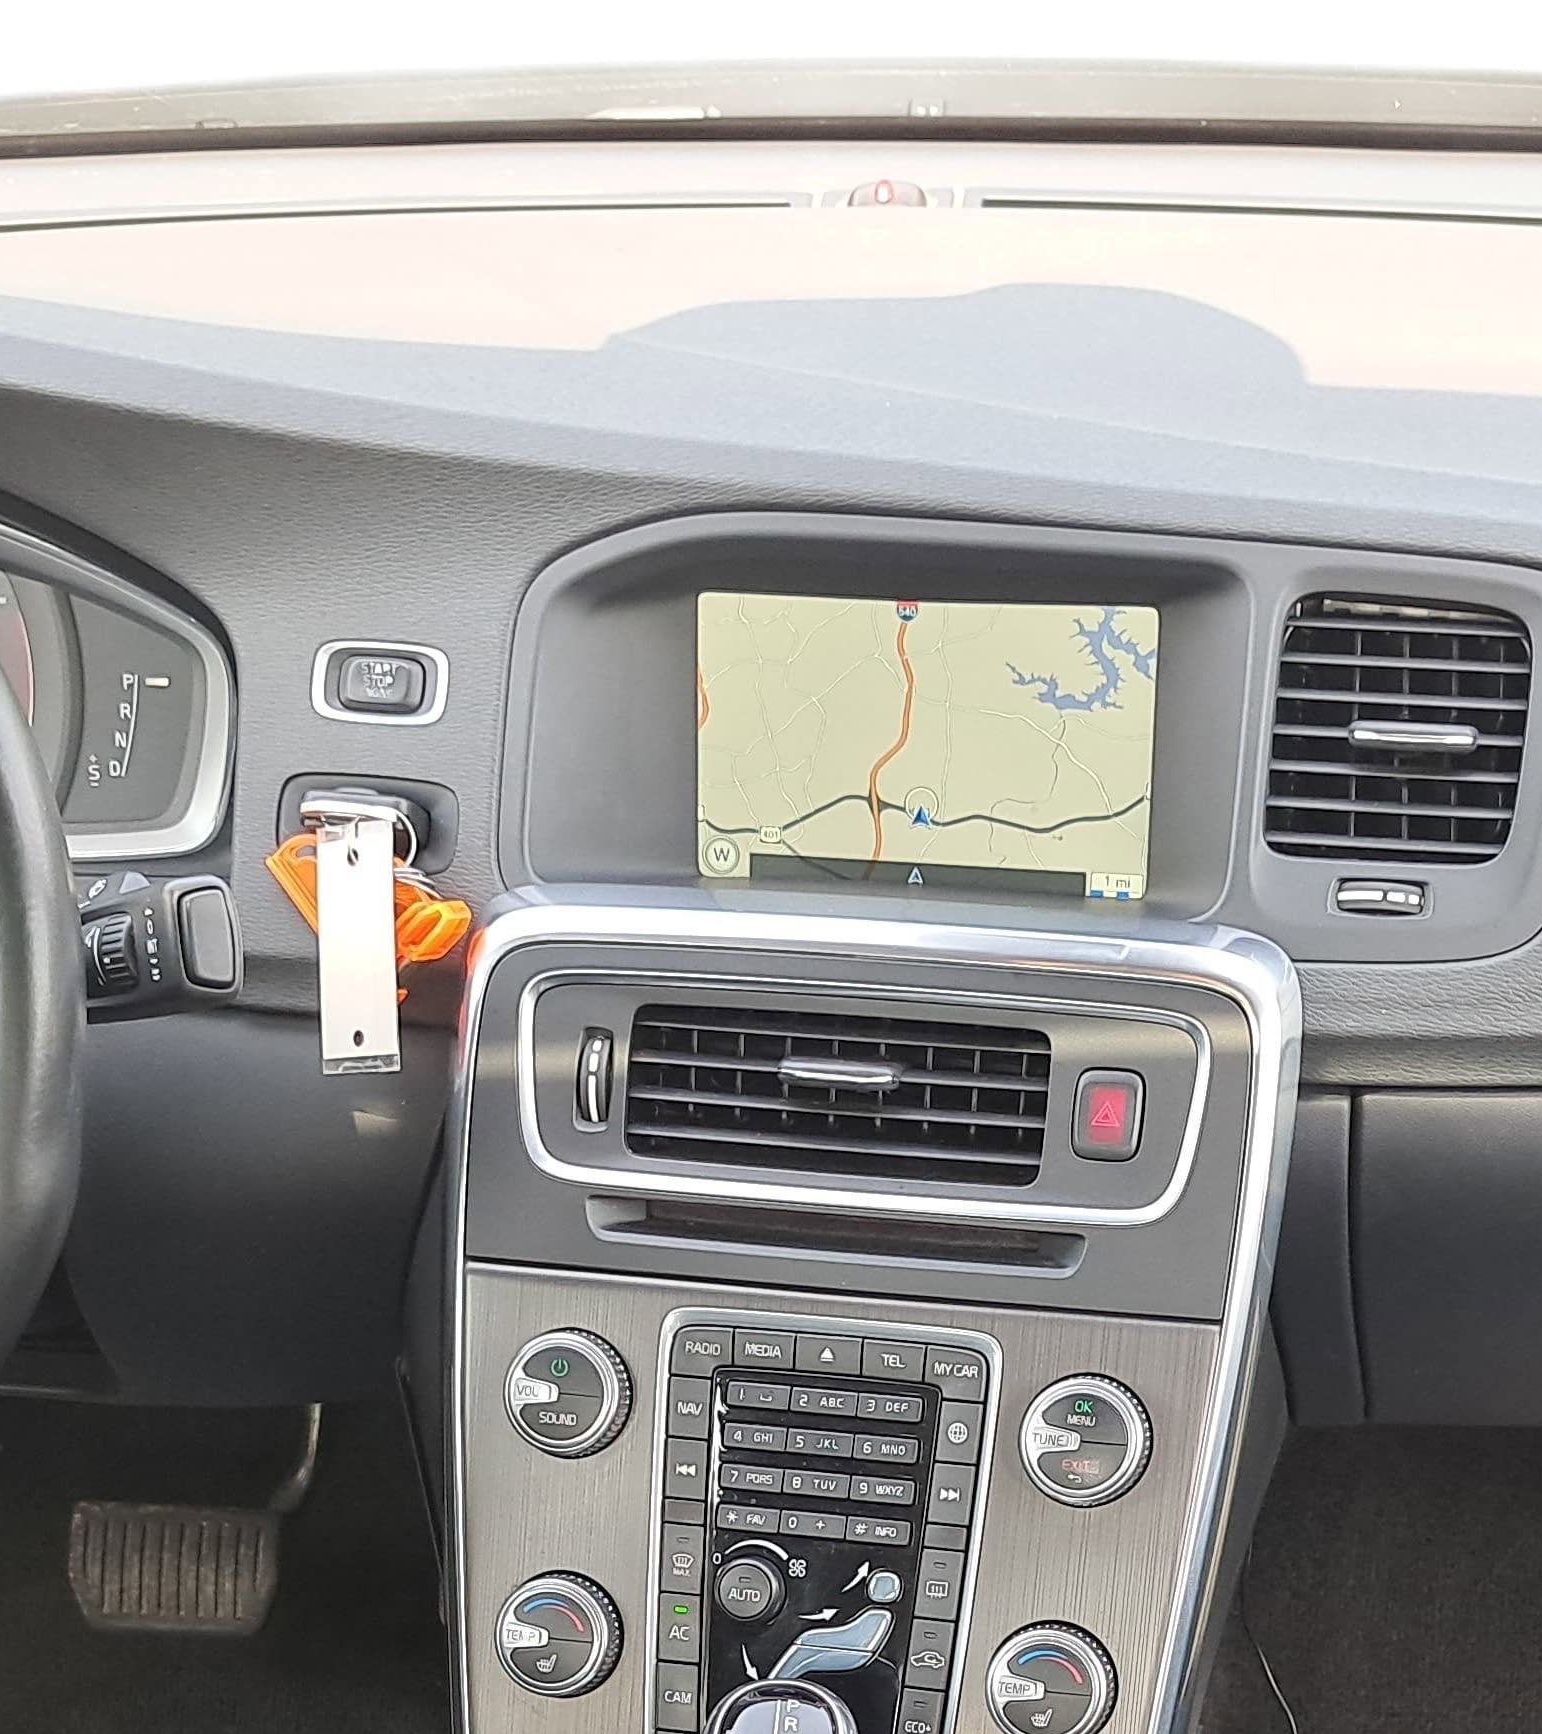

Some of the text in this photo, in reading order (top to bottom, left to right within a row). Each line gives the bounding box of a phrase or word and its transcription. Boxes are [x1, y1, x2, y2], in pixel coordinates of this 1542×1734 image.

[123, 674, 134, 690] P
[363, 675, 395, 687] STOP
[120, 703, 132, 719] R
[115, 732, 127, 748] N
[109, 761, 121, 777] D
[713, 847, 731, 862] W
[1115, 876, 1131, 889] mi
[685, 1340, 721, 1356] RADIO
[744, 1343, 782, 1359] MEDIA
[880, 1353, 907, 1369] TEL
[933, 1362, 979, 1379] MY CAR
[516, 1383, 540, 1398] VOL
[677, 1401, 703, 1416] NAV
[799, 1394, 845, 1409] 2 ABC
[866, 1399, 909, 1414] 3 DEF
[1074, 1400, 1093, 1414] OK
[538, 1411, 577, 1427] SOUND
[1066, 1413, 1096, 1427] MENU
[733, 1430, 774, 1444] 4 GHI
[795, 1435, 840, 1451] 5 JKL
[1032, 1431, 1065, 1447] TUNE
[862, 1441, 906, 1457] 6 MNO
[1061, 1459, 1091, 1471] EXIT
[729, 1470, 739, 1483] 7
[792, 1476, 837, 1492] 8 TUV
[858, 1481, 905, 1498] 9 WXYZ
[746, 1512, 766, 1527] FAV
[787, 1516, 798, 1529] 0
[875, 1524, 898, 1539] INFO
[672, 1567, 691, 1578] MAX
[728, 1588, 761, 1603] AUTO
[505, 1627, 537, 1643] TEMP
[668, 1624, 691, 1641] AC
[998, 1681, 1031, 1696] TEMP
[664, 1690, 693, 1705] CAM
[786, 1699, 801, 1713] P
[784, 1717, 798, 1732] R
